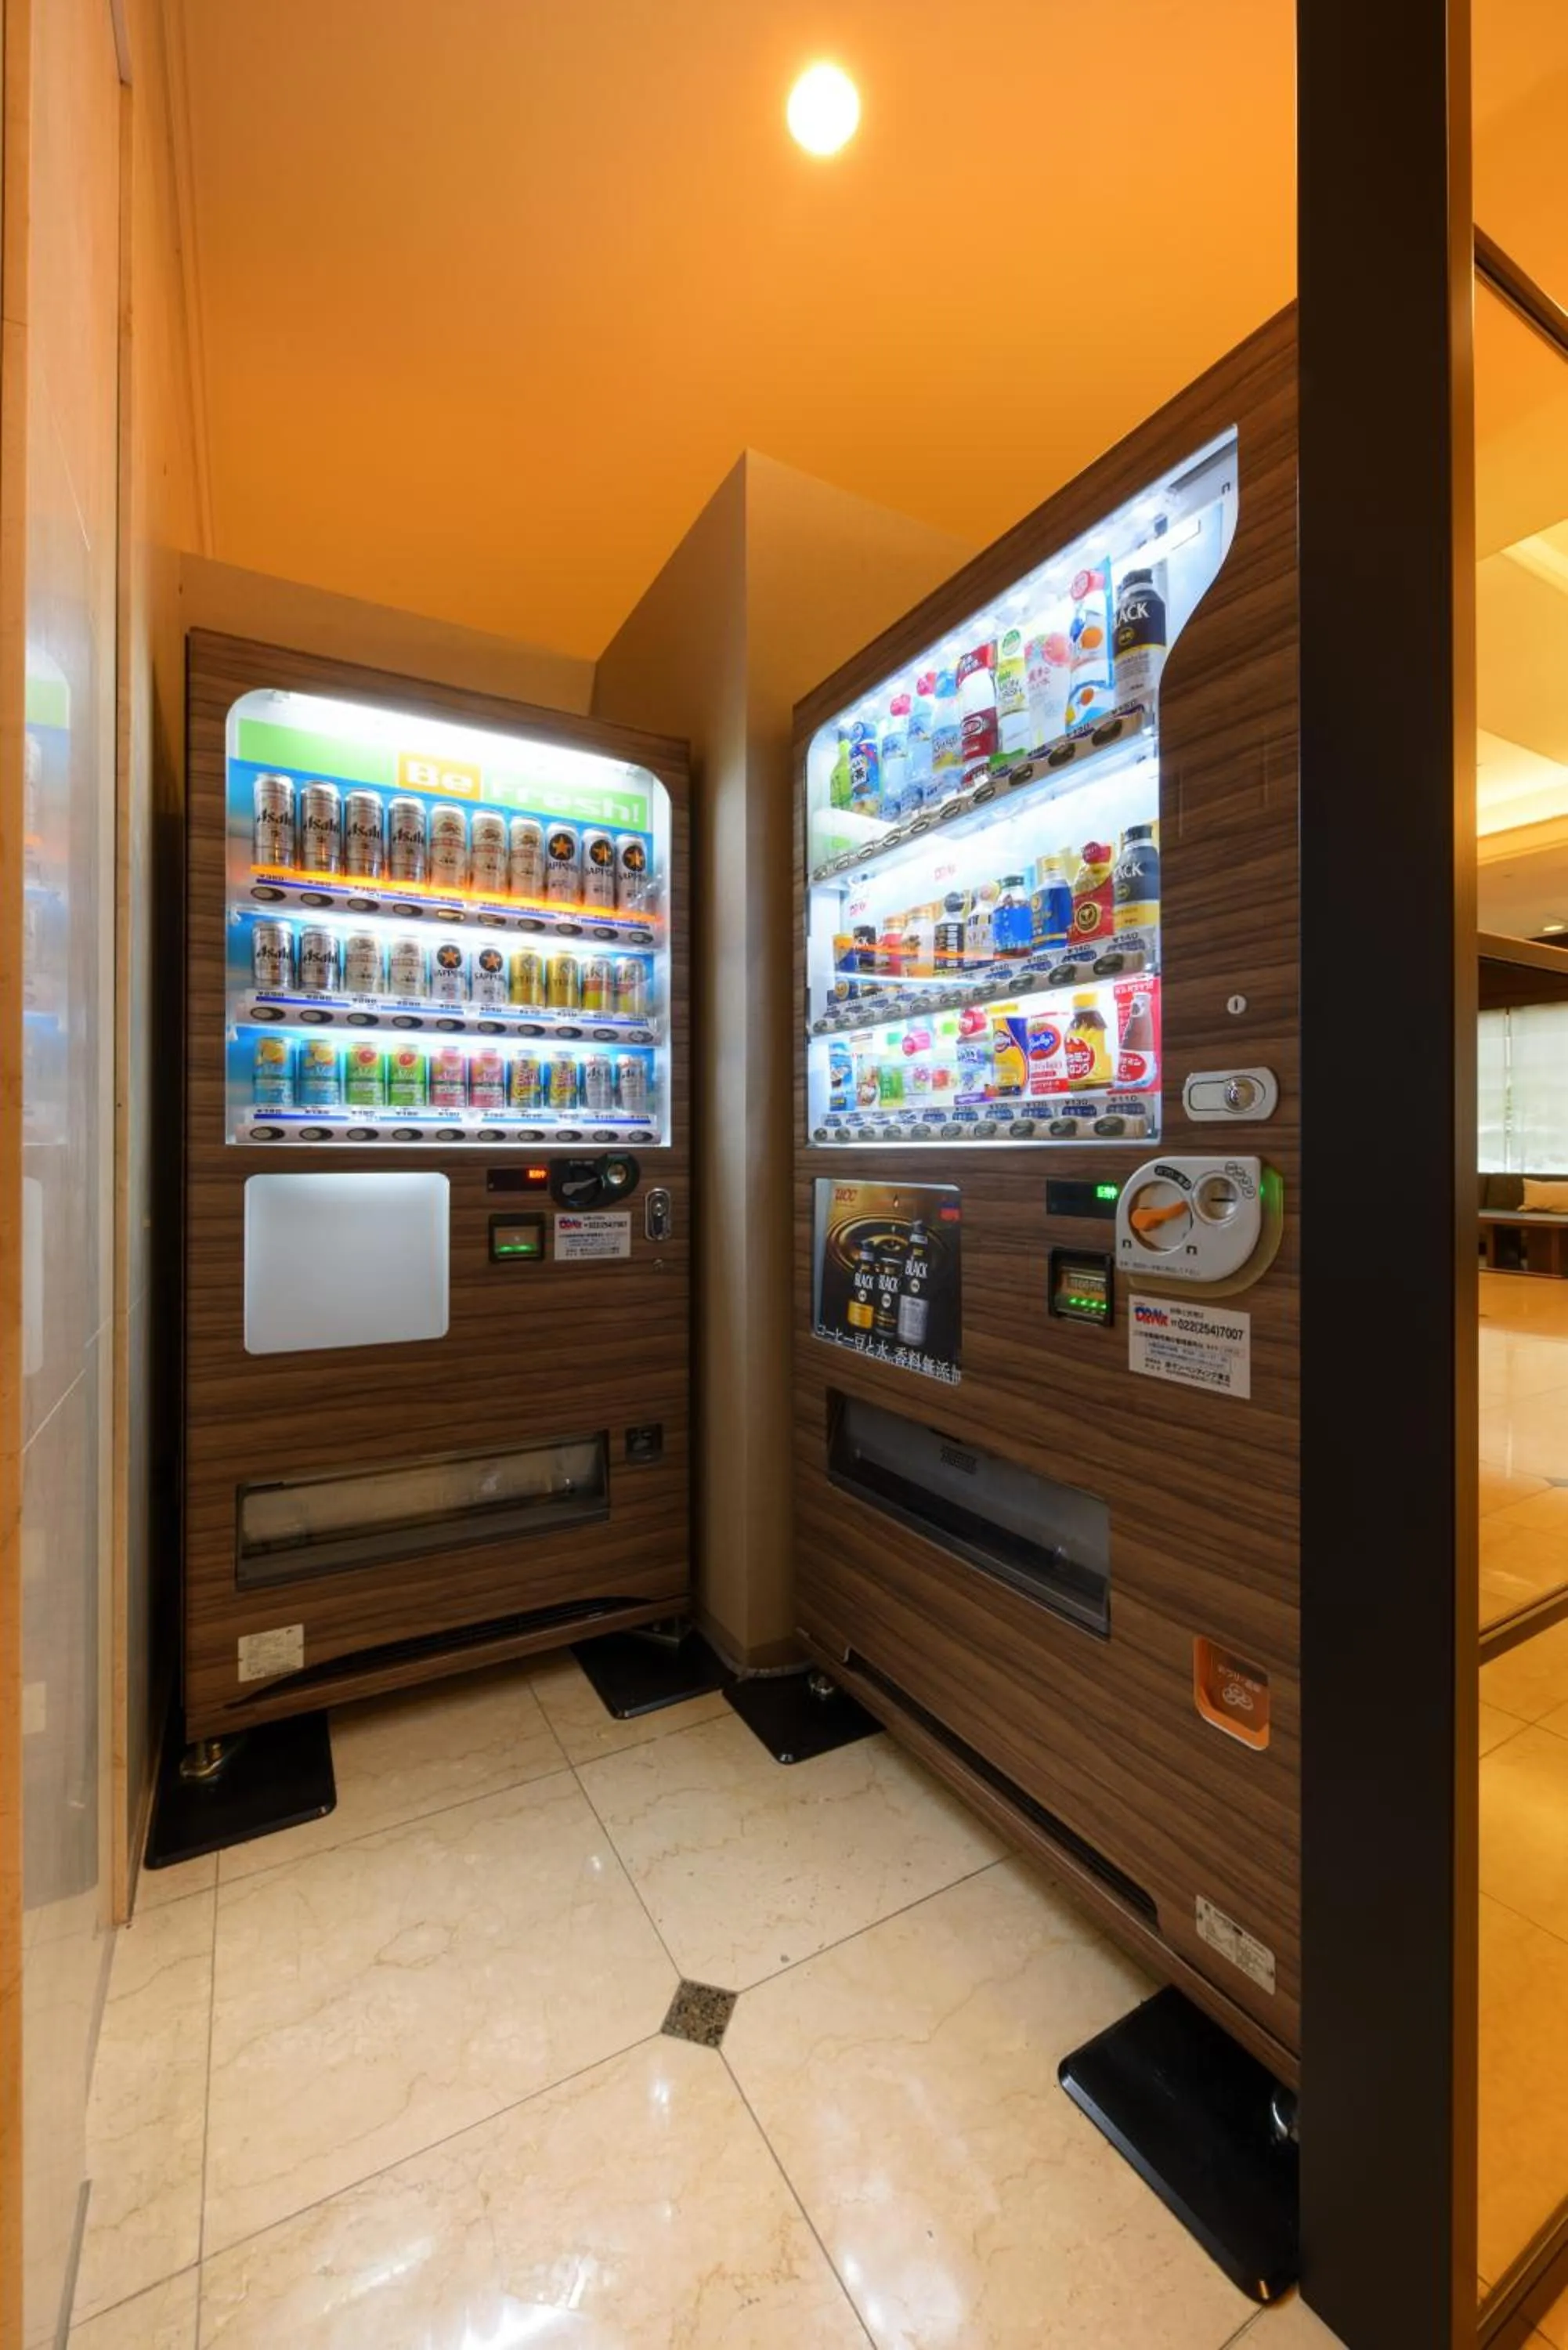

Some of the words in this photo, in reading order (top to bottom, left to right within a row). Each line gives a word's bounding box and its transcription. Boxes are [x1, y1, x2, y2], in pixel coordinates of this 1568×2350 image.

[405, 759, 475, 794] Be
[905, 1258, 928, 1278] BLACK
[854, 1272, 875, 1289] BLACK
[878, 1274, 899, 1292] BLACK
